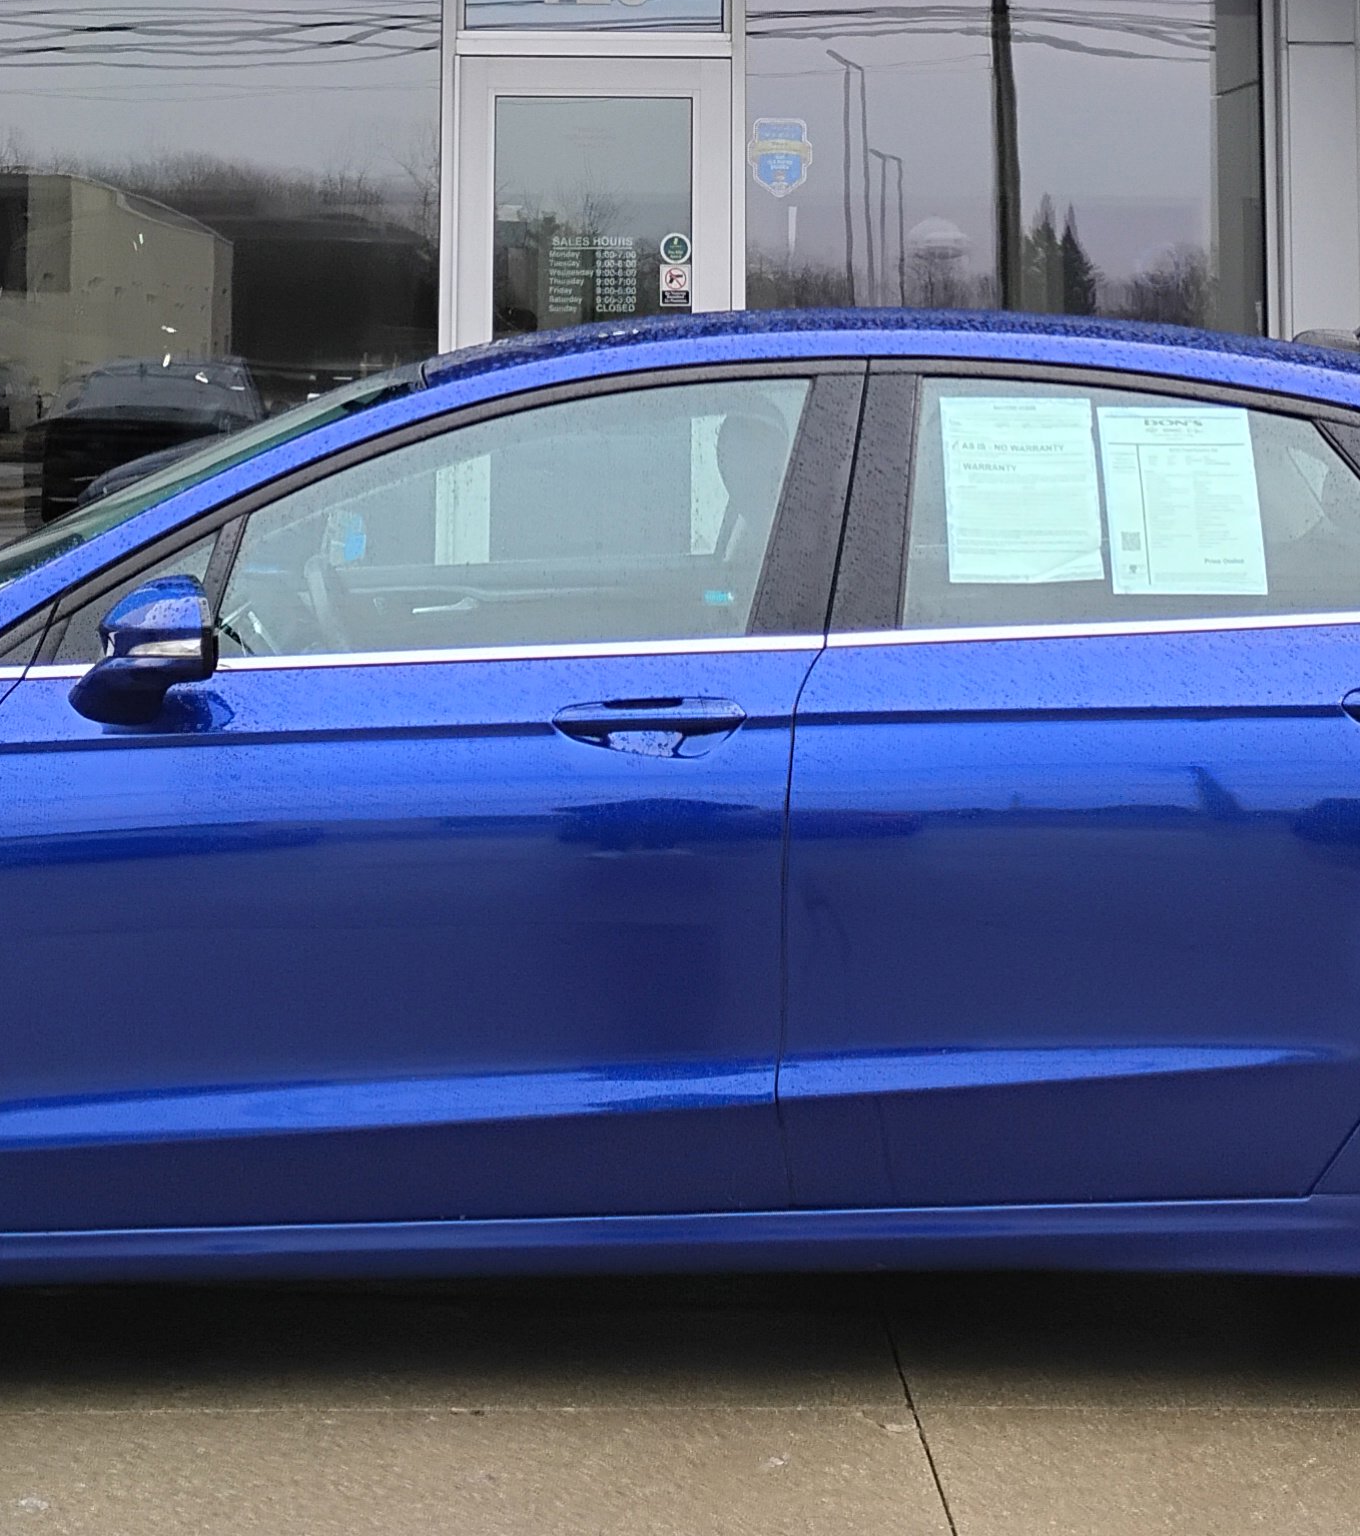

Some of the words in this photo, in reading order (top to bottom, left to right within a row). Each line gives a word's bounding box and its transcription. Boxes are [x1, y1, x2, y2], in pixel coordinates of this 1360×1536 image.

[552, 236, 590, 247] SALES
[593, 236, 633, 247] HOURS
[549, 250, 580, 259] Monday
[549, 278, 584, 286] Thursday
[549, 286, 572, 295] Friday
[549, 295, 582, 304] Saturday
[549, 304, 577, 313] Sunday
[595, 304, 636, 313] CLOSED
[1010, 443, 1064, 453] WARRANTY
[963, 462, 1017, 472] WARRANTY
